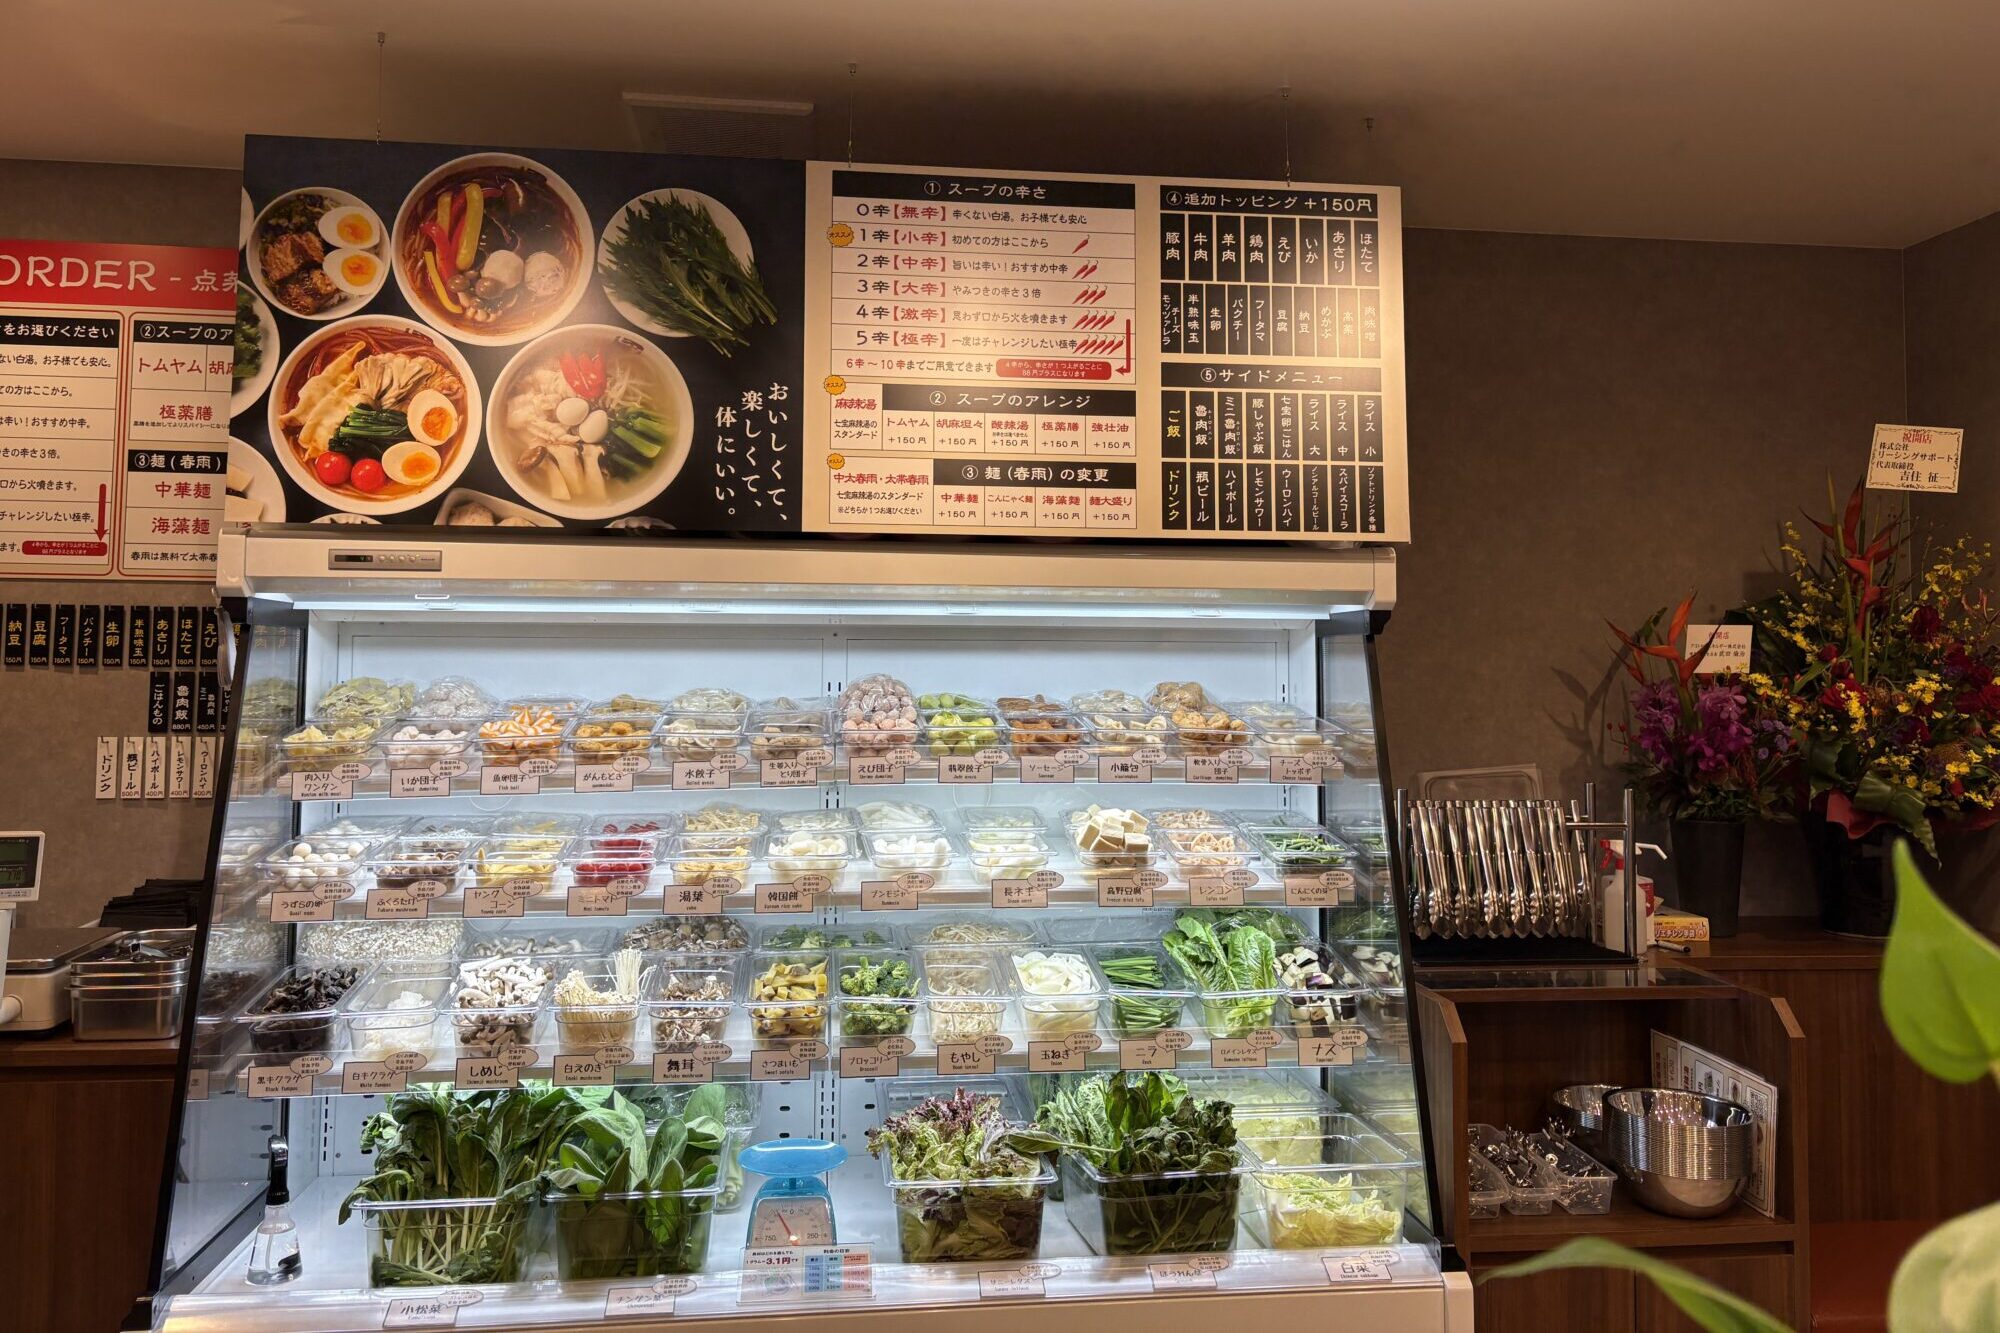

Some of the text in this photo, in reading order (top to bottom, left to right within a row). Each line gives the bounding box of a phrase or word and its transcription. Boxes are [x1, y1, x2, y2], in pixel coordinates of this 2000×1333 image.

[948, 182, 1047, 198] スープの辛さ
[1166, 191, 1372, 212] ④追加トッピング +150円
[1166, 232, 1180, 260] 豚肉
[1193, 233, 1208, 262] 牛肉
[1222, 234, 1236, 262] 羊肉
[1250, 235, 1263, 263] 鶏肉
[1278, 237, 1291, 263] えび
[1305, 238, 1318, 264] いか
[1333, 231, 1345, 273] あさり
[1360, 234, 1373, 273] ほたて
[1171, 307, 1180, 333] チーズ
[1188, 294, 1199, 343] 半熟味玉
[1210, 308, 1221, 330] 生卵
[1233, 299, 1243, 340] パクチー
[1255, 300, 1264, 341] フータマ
[1277, 310, 1288, 332] 豆腐
[1299, 310, 1310, 333] 納豆
[1321, 307, 1332, 339] めかぶ
[1343, 312, 1354, 336] 高菜
[1364, 307, 1376, 341] 肉味噌
[138, 358, 202, 375] トムヤム
[1200, 368, 1342, 384] ⑤サイドメニュー
[835, 398, 877, 410] 麻辣湯
[958, 392, 1090, 408] スープのアレンジ
[159, 405, 213, 421] 極薬膳
[887, 417, 929, 427] トムヤム
[1167, 410, 1180, 438] ご飯
[1195, 405, 1207, 445] 魯肉飯
[834, 430, 877, 439] スタンダード
[991, 421, 1029, 431] 酸辣湯
[1042, 421, 1079, 432] 極薬膳
[1092, 422, 1129, 433] 強壮油
[1253, 398, 1264, 454] 豚しゃぶ飯
[1281, 396, 1291, 458] 七宝卵ごはん
[1309, 399, 1320, 456] ライス 大
[1337, 400, 1348, 456] ライス 中
[1364, 400, 1376, 457] ライス 小
[1903, 433, 1932, 444] 祝開店
[741, 390, 763, 507] 楽しくて、
[767, 382, 788, 521] おいしくて、
[1878, 450, 1953, 462] リーシングサポート
[1880, 442, 1909, 451] 株式会社
[715, 406, 737, 515] 体にいい。
[1877, 461, 1914, 470] 代表取締役
[155, 481, 212, 499] 中華麺
[941, 493, 979, 504] 中華麺
[1043, 495, 1081, 506] 海藻麺
[1089, 496, 1133, 507] 麺大盛り
[1169, 471, 1180, 522] ドリンク
[1196, 471, 1209, 522] 瓶ビール
[1225, 470, 1236, 524] ハイボール
[1254, 468, 1264, 527] レモンサワー
[1282, 468, 1292, 527] ウーロンハイ
[1339, 468, 1348, 530] スパイスコーラ
[152, 517, 210, 535] 海藻麺
[8, 621, 22, 646] 納豆
[33, 622, 46, 646] 豆腐
[58, 617, 69, 654] フータマ
[83, 617, 93, 656] パクチー
[106, 622, 120, 647] 生卵
[134, 619, 144, 657] 半熟味玉
[156, 619, 169, 654] あさり
[181, 620, 192, 654] ほたて
[204, 623, 217, 648] えび
[152, 685, 163, 725] ごはんもの
[100, 755, 113, 792] ドリンク
[125, 754, 138, 790] 瓶ビール
[150, 751, 160, 789] ハイボール
[176, 751, 184, 789] レモンサワー
[199, 751, 209, 789] ウーロンハイ
[685, 769, 715, 778] 水餃子
[858, 764, 893, 773] えび団子
[1110, 763, 1139, 772] 小籠包
[1280, 758, 1300, 767] チーズ
[401, 776, 438, 786] いか団子
[493, 774, 526, 783] 魚卵団子
[679, 890, 704, 903] 湯葉
[1199, 885, 1232, 895] レンコン
[490, 899, 515, 909] コーン
[950, 1051, 981, 1063] もやし
[1311, 1044, 1336, 1057] ナス
[469, 1065, 502, 1077] しめじ
[667, 1058, 694, 1072] 舞茸
